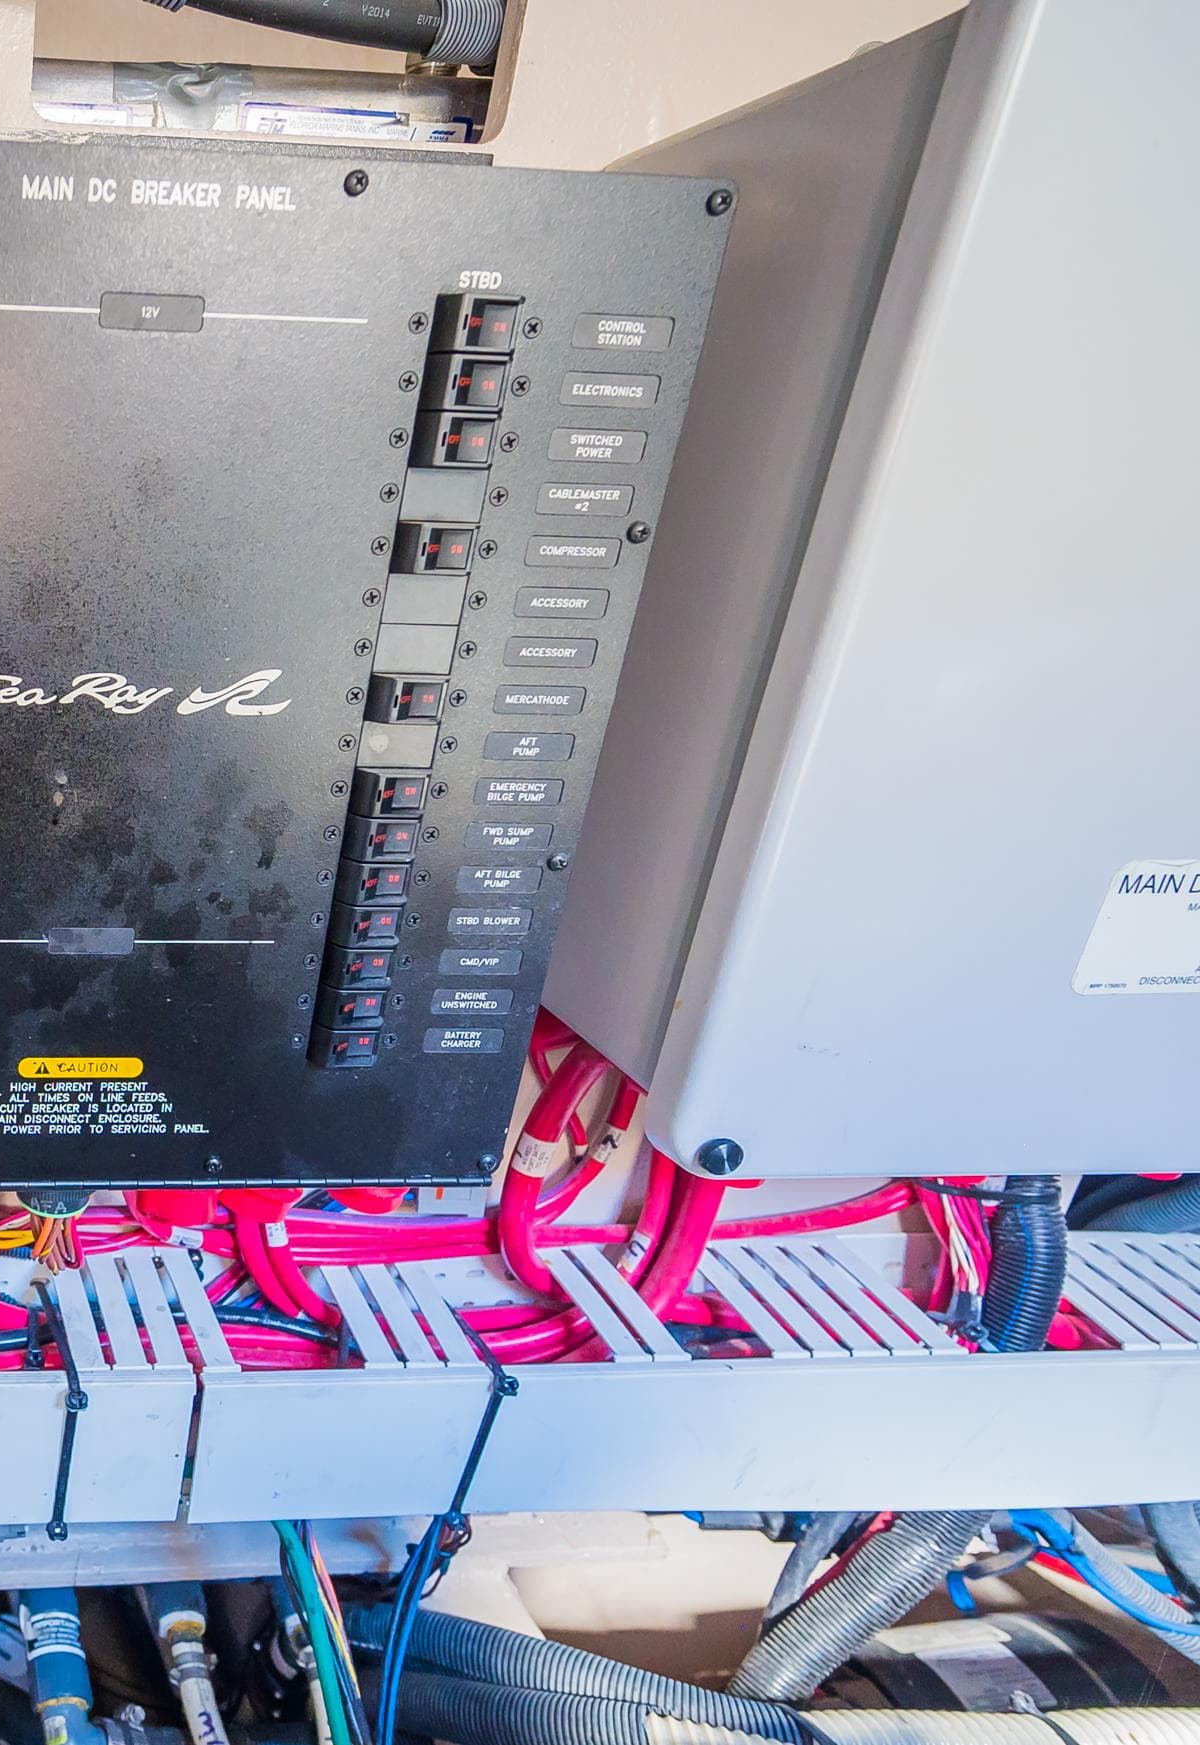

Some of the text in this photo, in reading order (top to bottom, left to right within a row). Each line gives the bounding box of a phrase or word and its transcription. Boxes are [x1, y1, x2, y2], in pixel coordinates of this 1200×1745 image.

[362, 5, 391, 18] Y2014
[22, 175, 296, 210] MAIN DC BREAKER PANEL
[459, 272, 502, 289] STBD
[141, 305, 160, 318] 12V
[598, 321, 646, 333] CONTROL
[597, 334, 642, 346] STATION
[573, 385, 643, 397] ELECTRONICS
[570, 435, 622, 447] SWITCHED
[576, 446, 611, 457] POWER
[549, 489, 620, 501] CABLEMASTER
[540, 546, 606, 556] COMPRESSOR
[531, 598, 589, 608] ACCESSORY
[520, 648, 577, 657] ACCESSORY
[59, 672, 173, 714] Ray
[506, 695, 570, 705] MERCATHODE
[519, 737, 536, 746] AFT
[513, 746, 540, 756] PUMP
[490, 783, 547, 792] EMERGENCY
[488, 792, 544, 802] BILGE PUMP
[483, 827, 534, 836] FWD SUMP
[493, 837, 519, 845] PUMP
[475, 870, 522, 879] AFT BILGE
[484, 879, 510, 887] PUMP
[1118, 874, 1186, 894] MAIN
[456, 917, 520, 925] STBD BLOWER
[460, 958, 499, 966] CMD/VIP
[455, 992, 488, 1000] ENGINE
[441, 1000, 497, 1009] UNSWITCHED
[445, 1031, 481, 1039] BATTERY
[441, 1039, 481, 1048] CHARGER
[57, 1063, 118, 1073] CAUTION
[10, 1082, 148, 1092] HIGH CURRENT PRESENT
[9, 1094, 29, 1103] ALL
[38, 1093, 70, 1103] TIMES
[78, 1094, 93, 1103] ON
[100, 1093, 125, 1103] LINE
[132, 1094, 168, 1103] FEEDS.
[32, 1104, 80, 1113] BREAKER
[88, 1104, 98, 1113] IS
[107, 1104, 154, 1113] LOCATED
[161, 1104, 172, 1113] IN
[24, 1115, 91, 1123] DISCONNECT
[98, 1114, 161, 1123] ENCLOSURE.
[3, 1125, 41, 1134] POWER
[49, 1125, 81, 1134] PRIOR
[90, 1125, 103, 1134] TO
[112, 1125, 166, 1134] SERVICING
[174, 1124, 209, 1133] PANEL.
